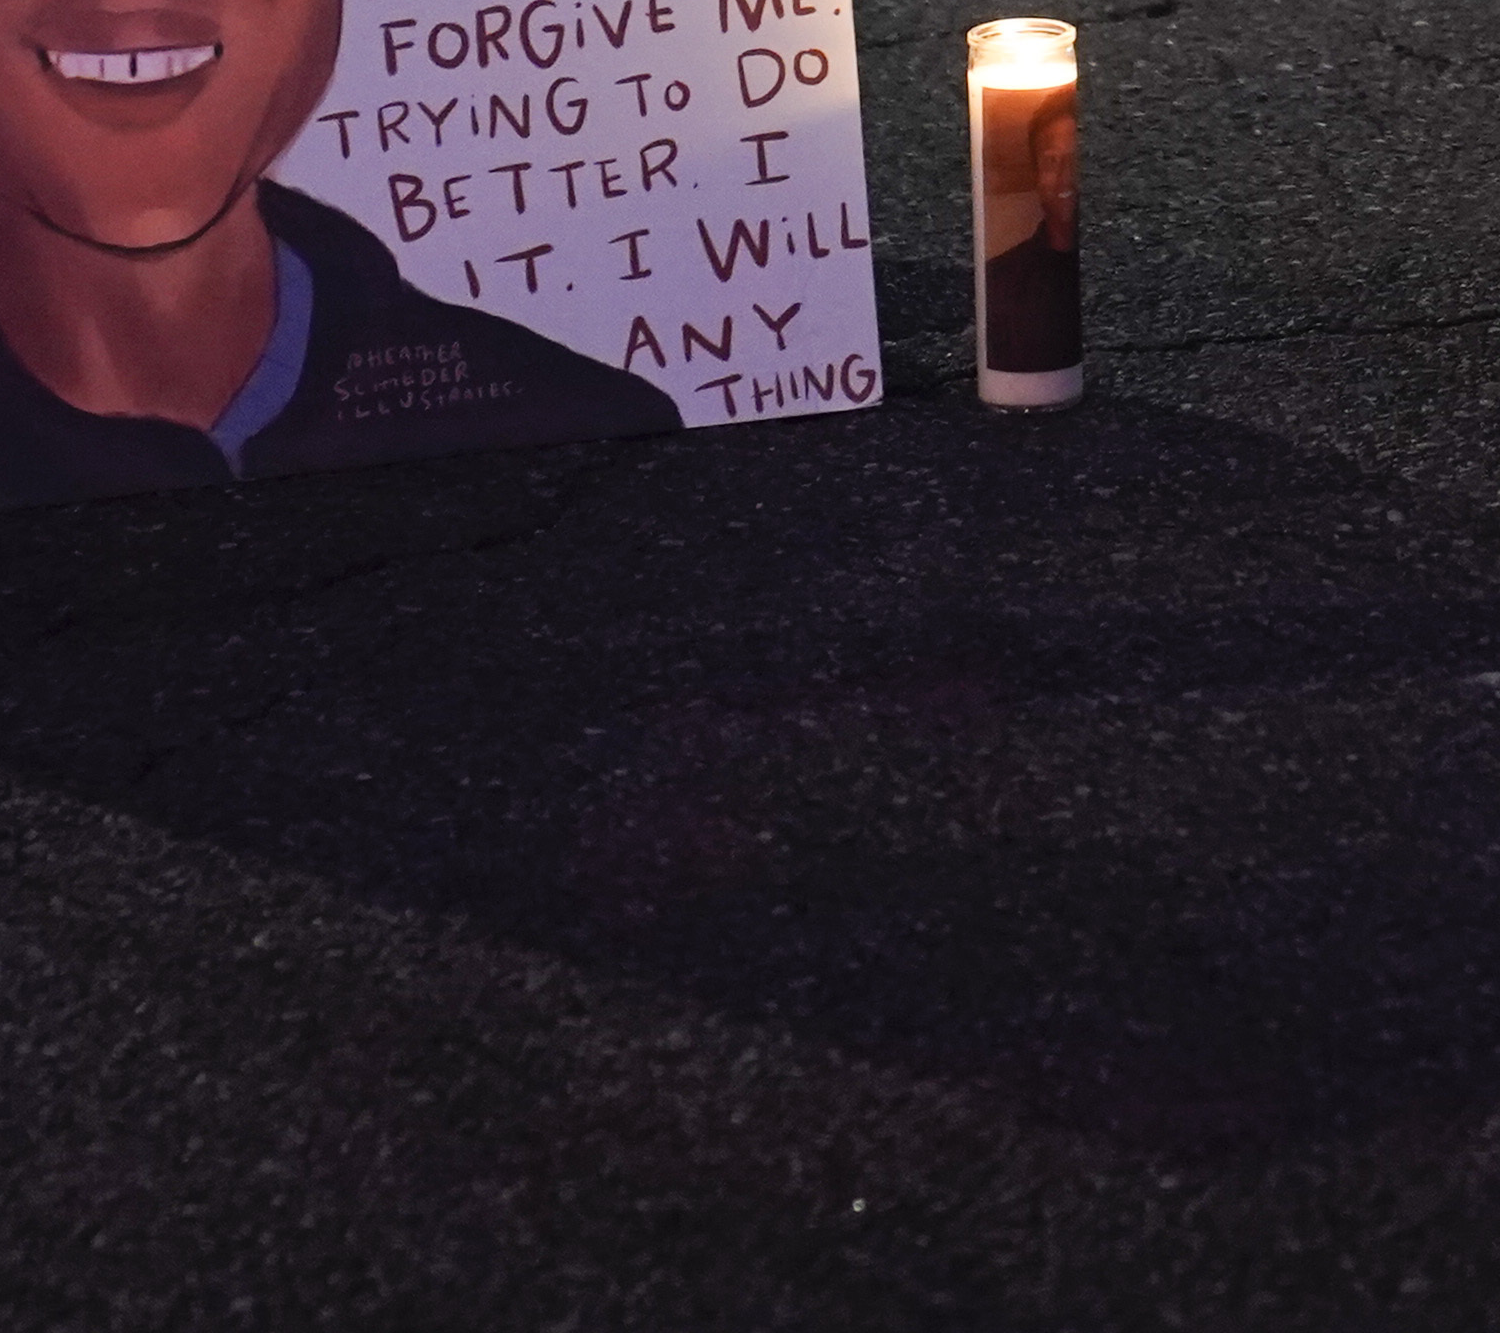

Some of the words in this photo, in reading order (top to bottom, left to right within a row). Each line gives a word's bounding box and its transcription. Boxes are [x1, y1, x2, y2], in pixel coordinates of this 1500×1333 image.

[615, 73, 691, 117] TO
[736, 47, 829, 109] DO
[740, 131, 790, 186] I
[610, 229, 652, 281] I
[623, 302, 801, 369] ANY
[695, 353, 876, 418] THING
